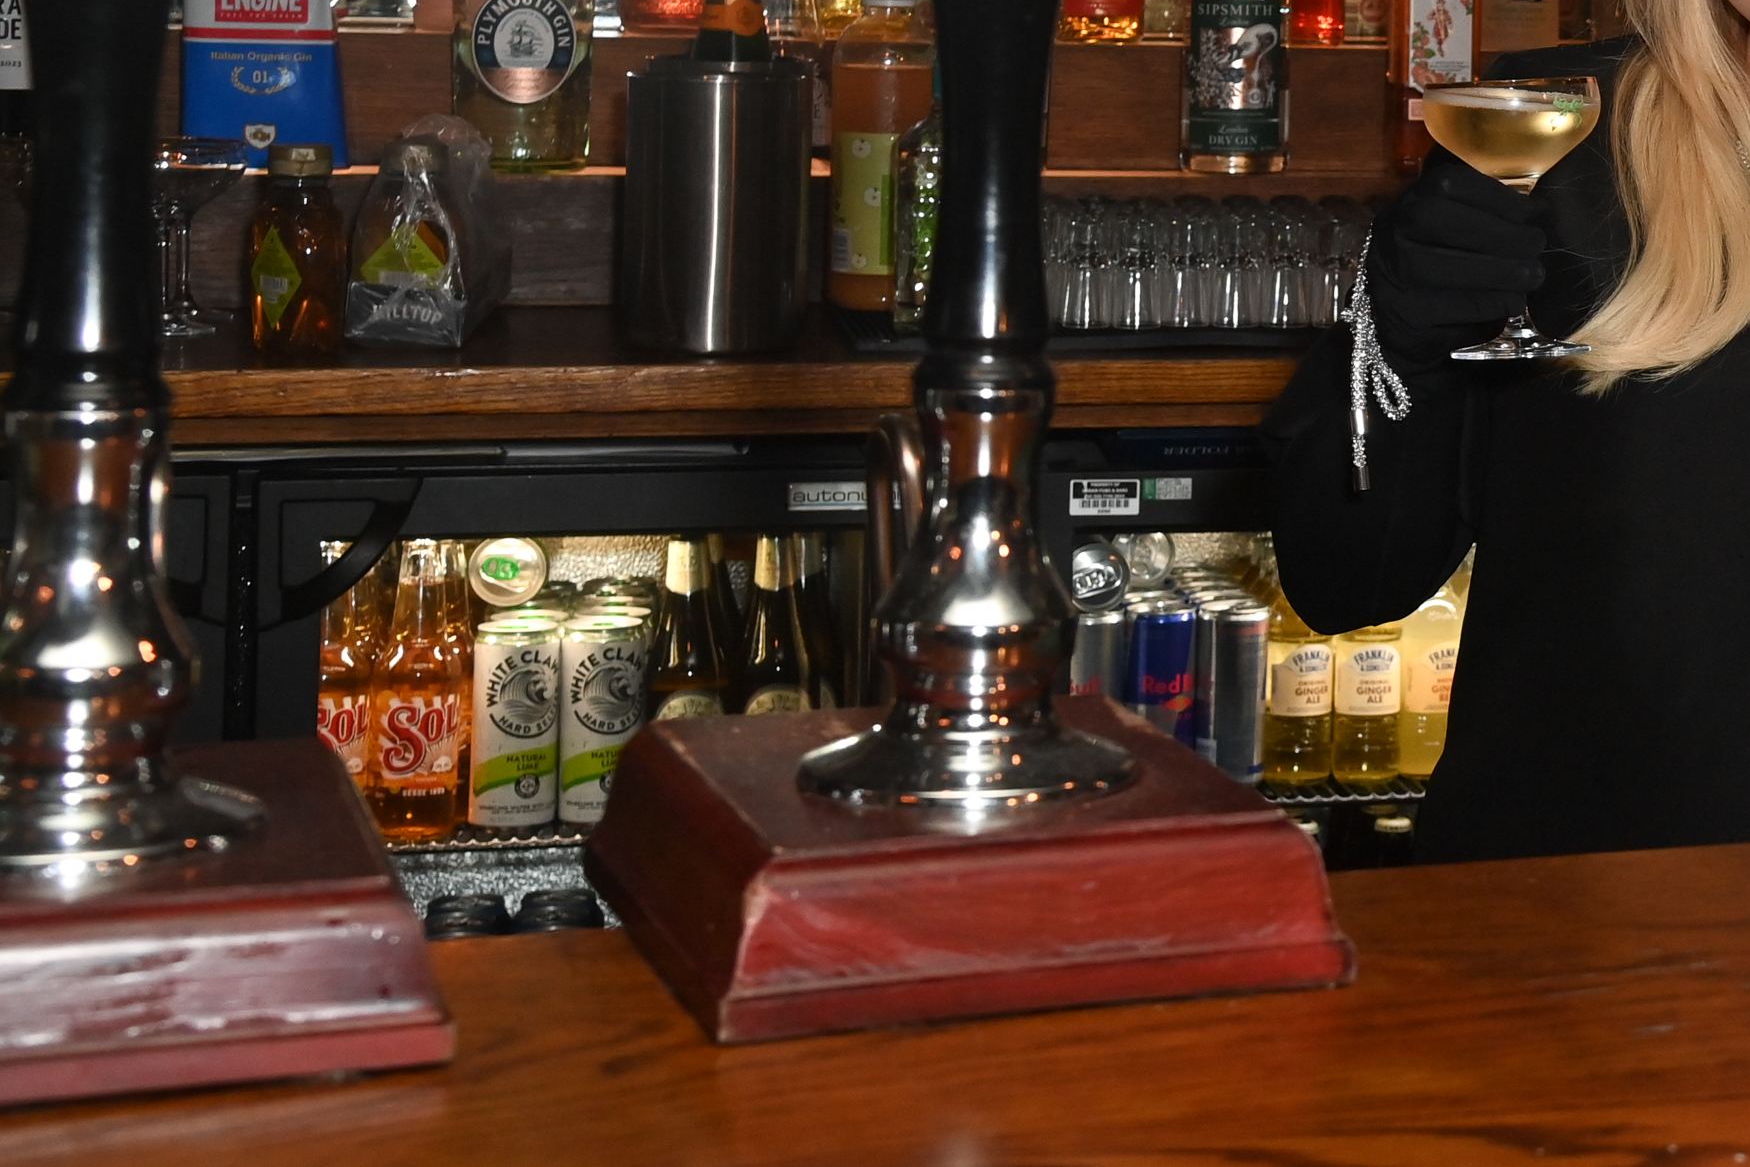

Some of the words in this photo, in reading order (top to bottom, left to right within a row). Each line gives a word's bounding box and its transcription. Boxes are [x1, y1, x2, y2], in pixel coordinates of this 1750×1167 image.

[1197, 2, 1273, 17] SIPSMITH
[553, 15, 571, 47] GIN
[211, 51, 244, 62] Italian
[247, 51, 291, 63] Organic
[293, 52, 313, 62] Gin
[252, 70, 268, 83] 01
[1208, 135, 1233, 145] DRY
[1235, 136, 1258, 146] GIN
[486, 656, 518, 708] WHITE
[570, 653, 600, 704] WHITE
[1142, 673, 1182, 694] Red
[1295, 686, 1329, 696] GINGER
[1356, 685, 1392, 696] GINGER
[1305, 695, 1321, 704] ALE
[1366, 695, 1383, 704] ALE
[500, 714, 532, 734] HARD
[583, 712, 616, 732] HARD
[507, 753, 547, 764] NATURAL
[516, 762, 540, 772] LIME
